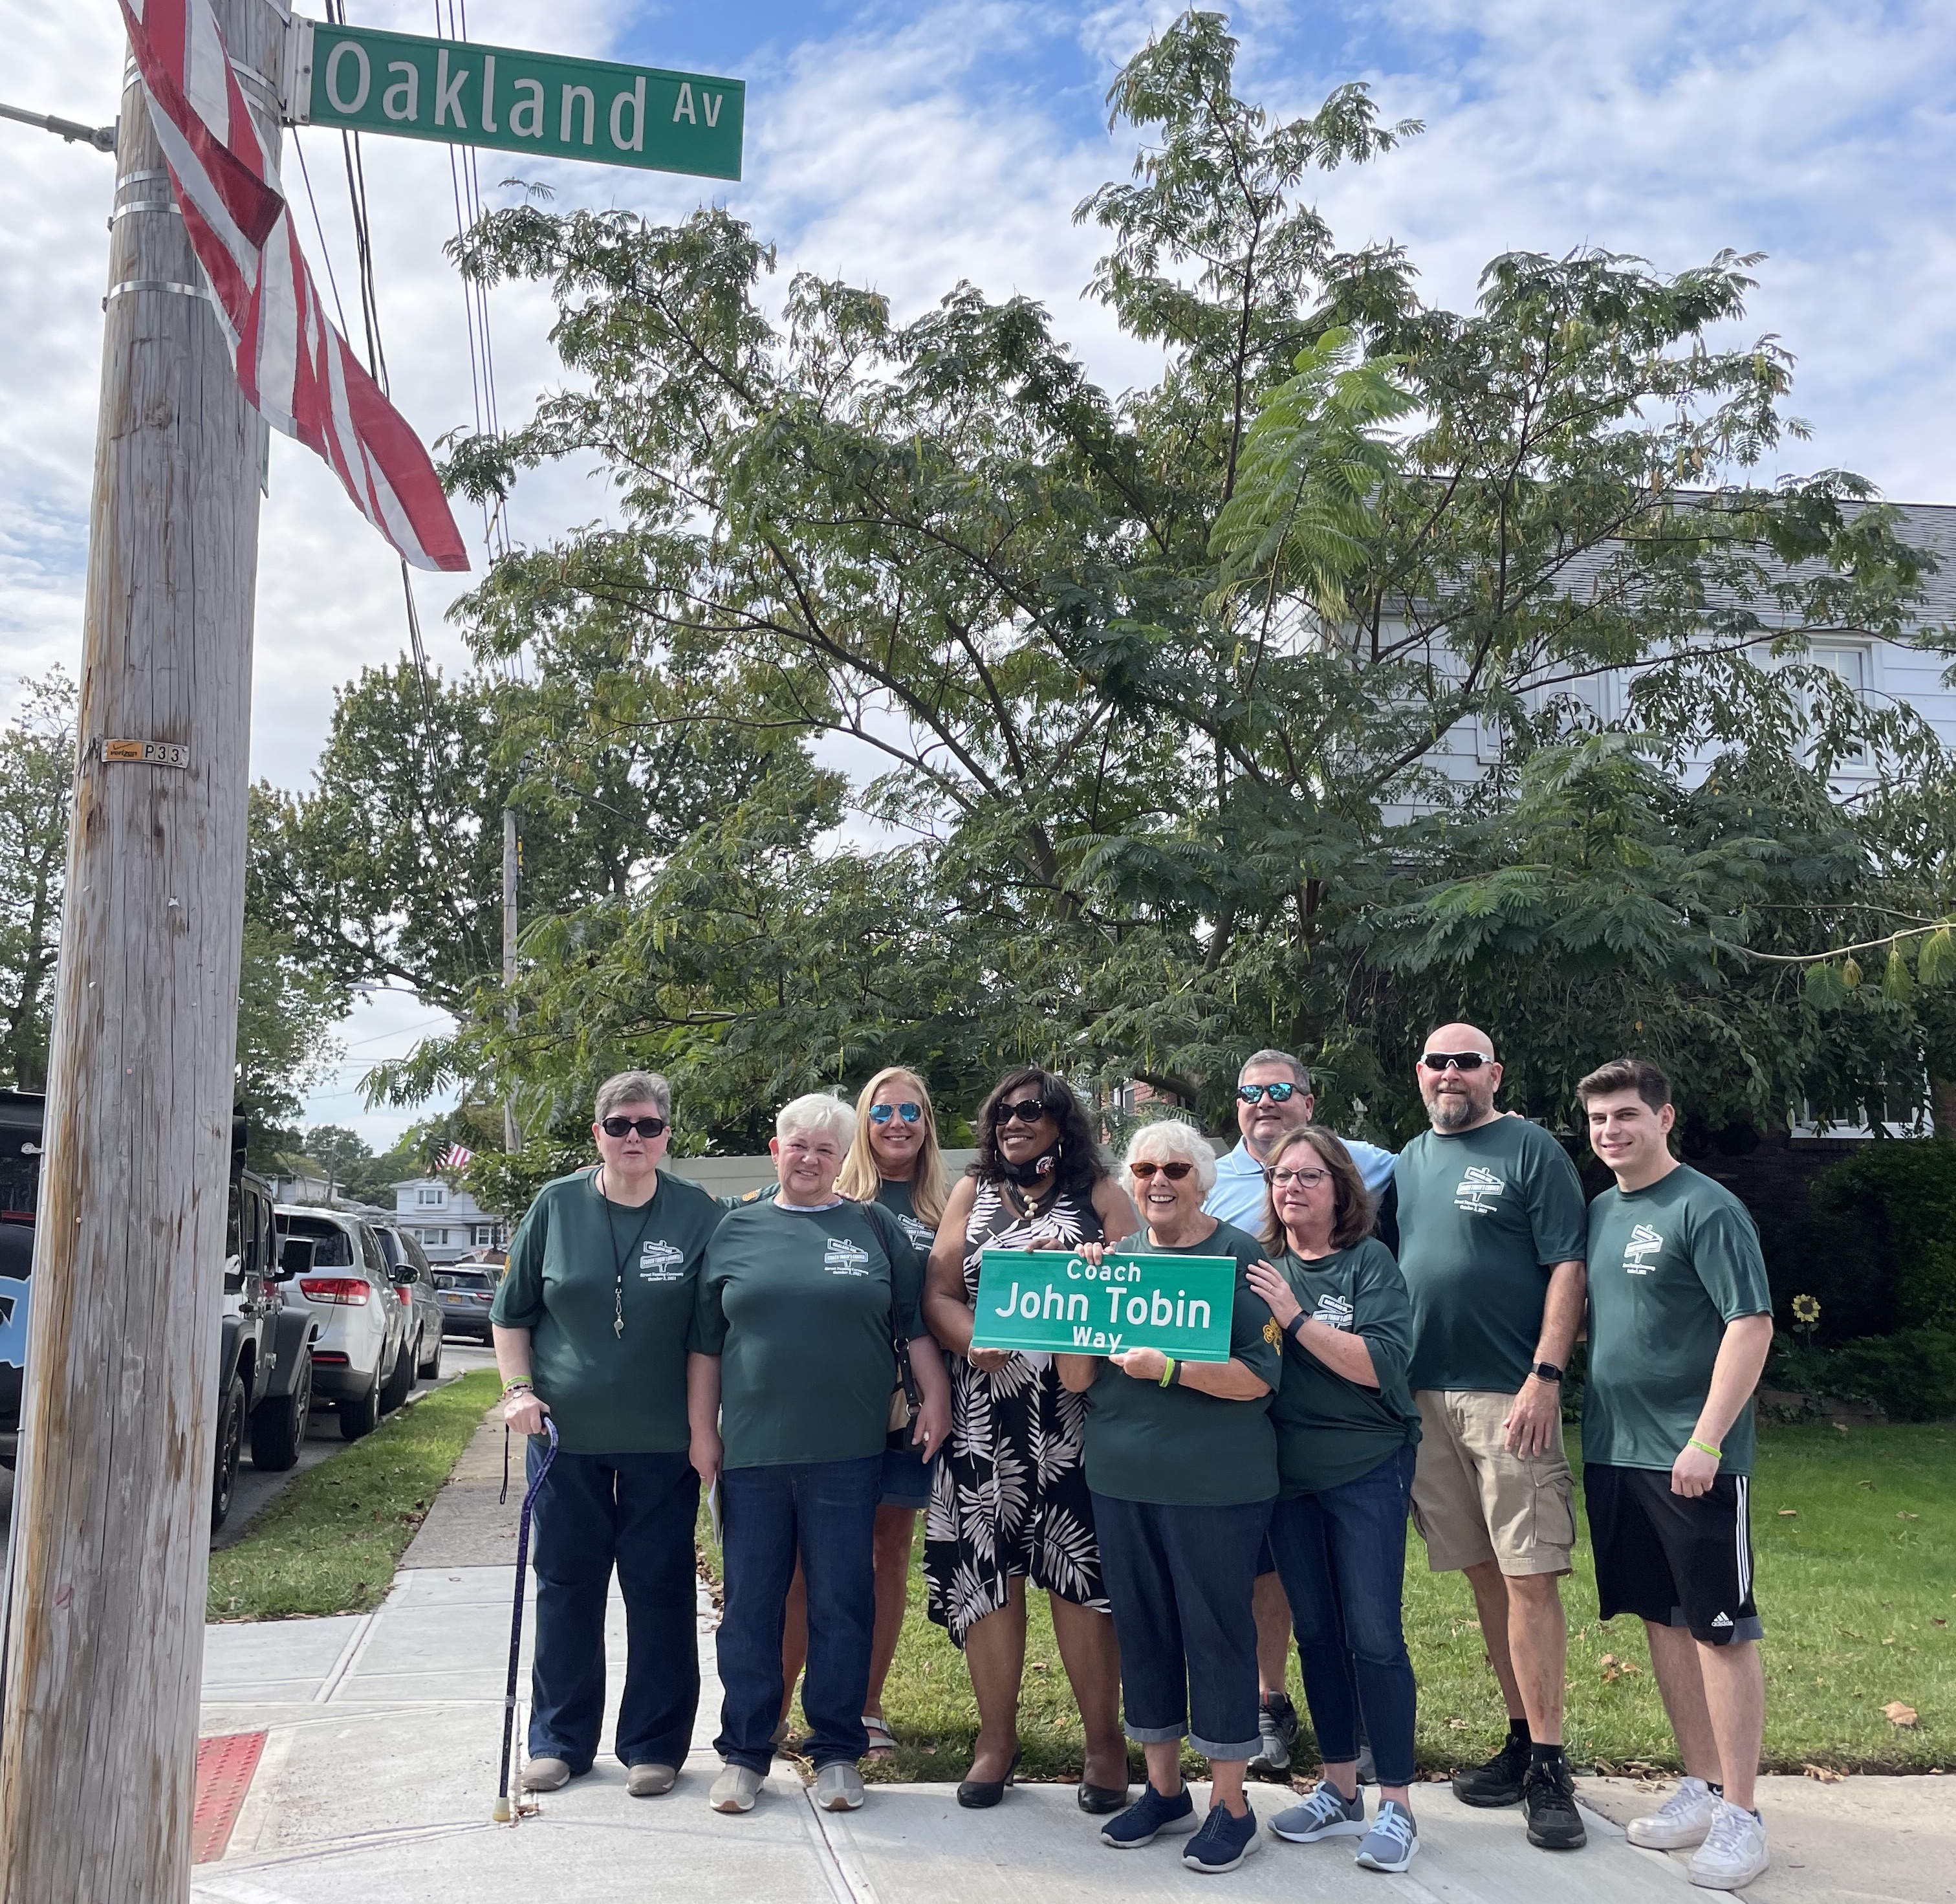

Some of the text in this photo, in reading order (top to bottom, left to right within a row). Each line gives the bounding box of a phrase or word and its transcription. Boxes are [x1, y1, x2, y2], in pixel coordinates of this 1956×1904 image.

[325, 41, 723, 152] Oakland Av
[146, 745, 179, 762] P33
[1067, 1259, 1142, 1282] Coach
[994, 1282, 1211, 1329] John Tobin
[1072, 1326, 1123, 1354] Way
